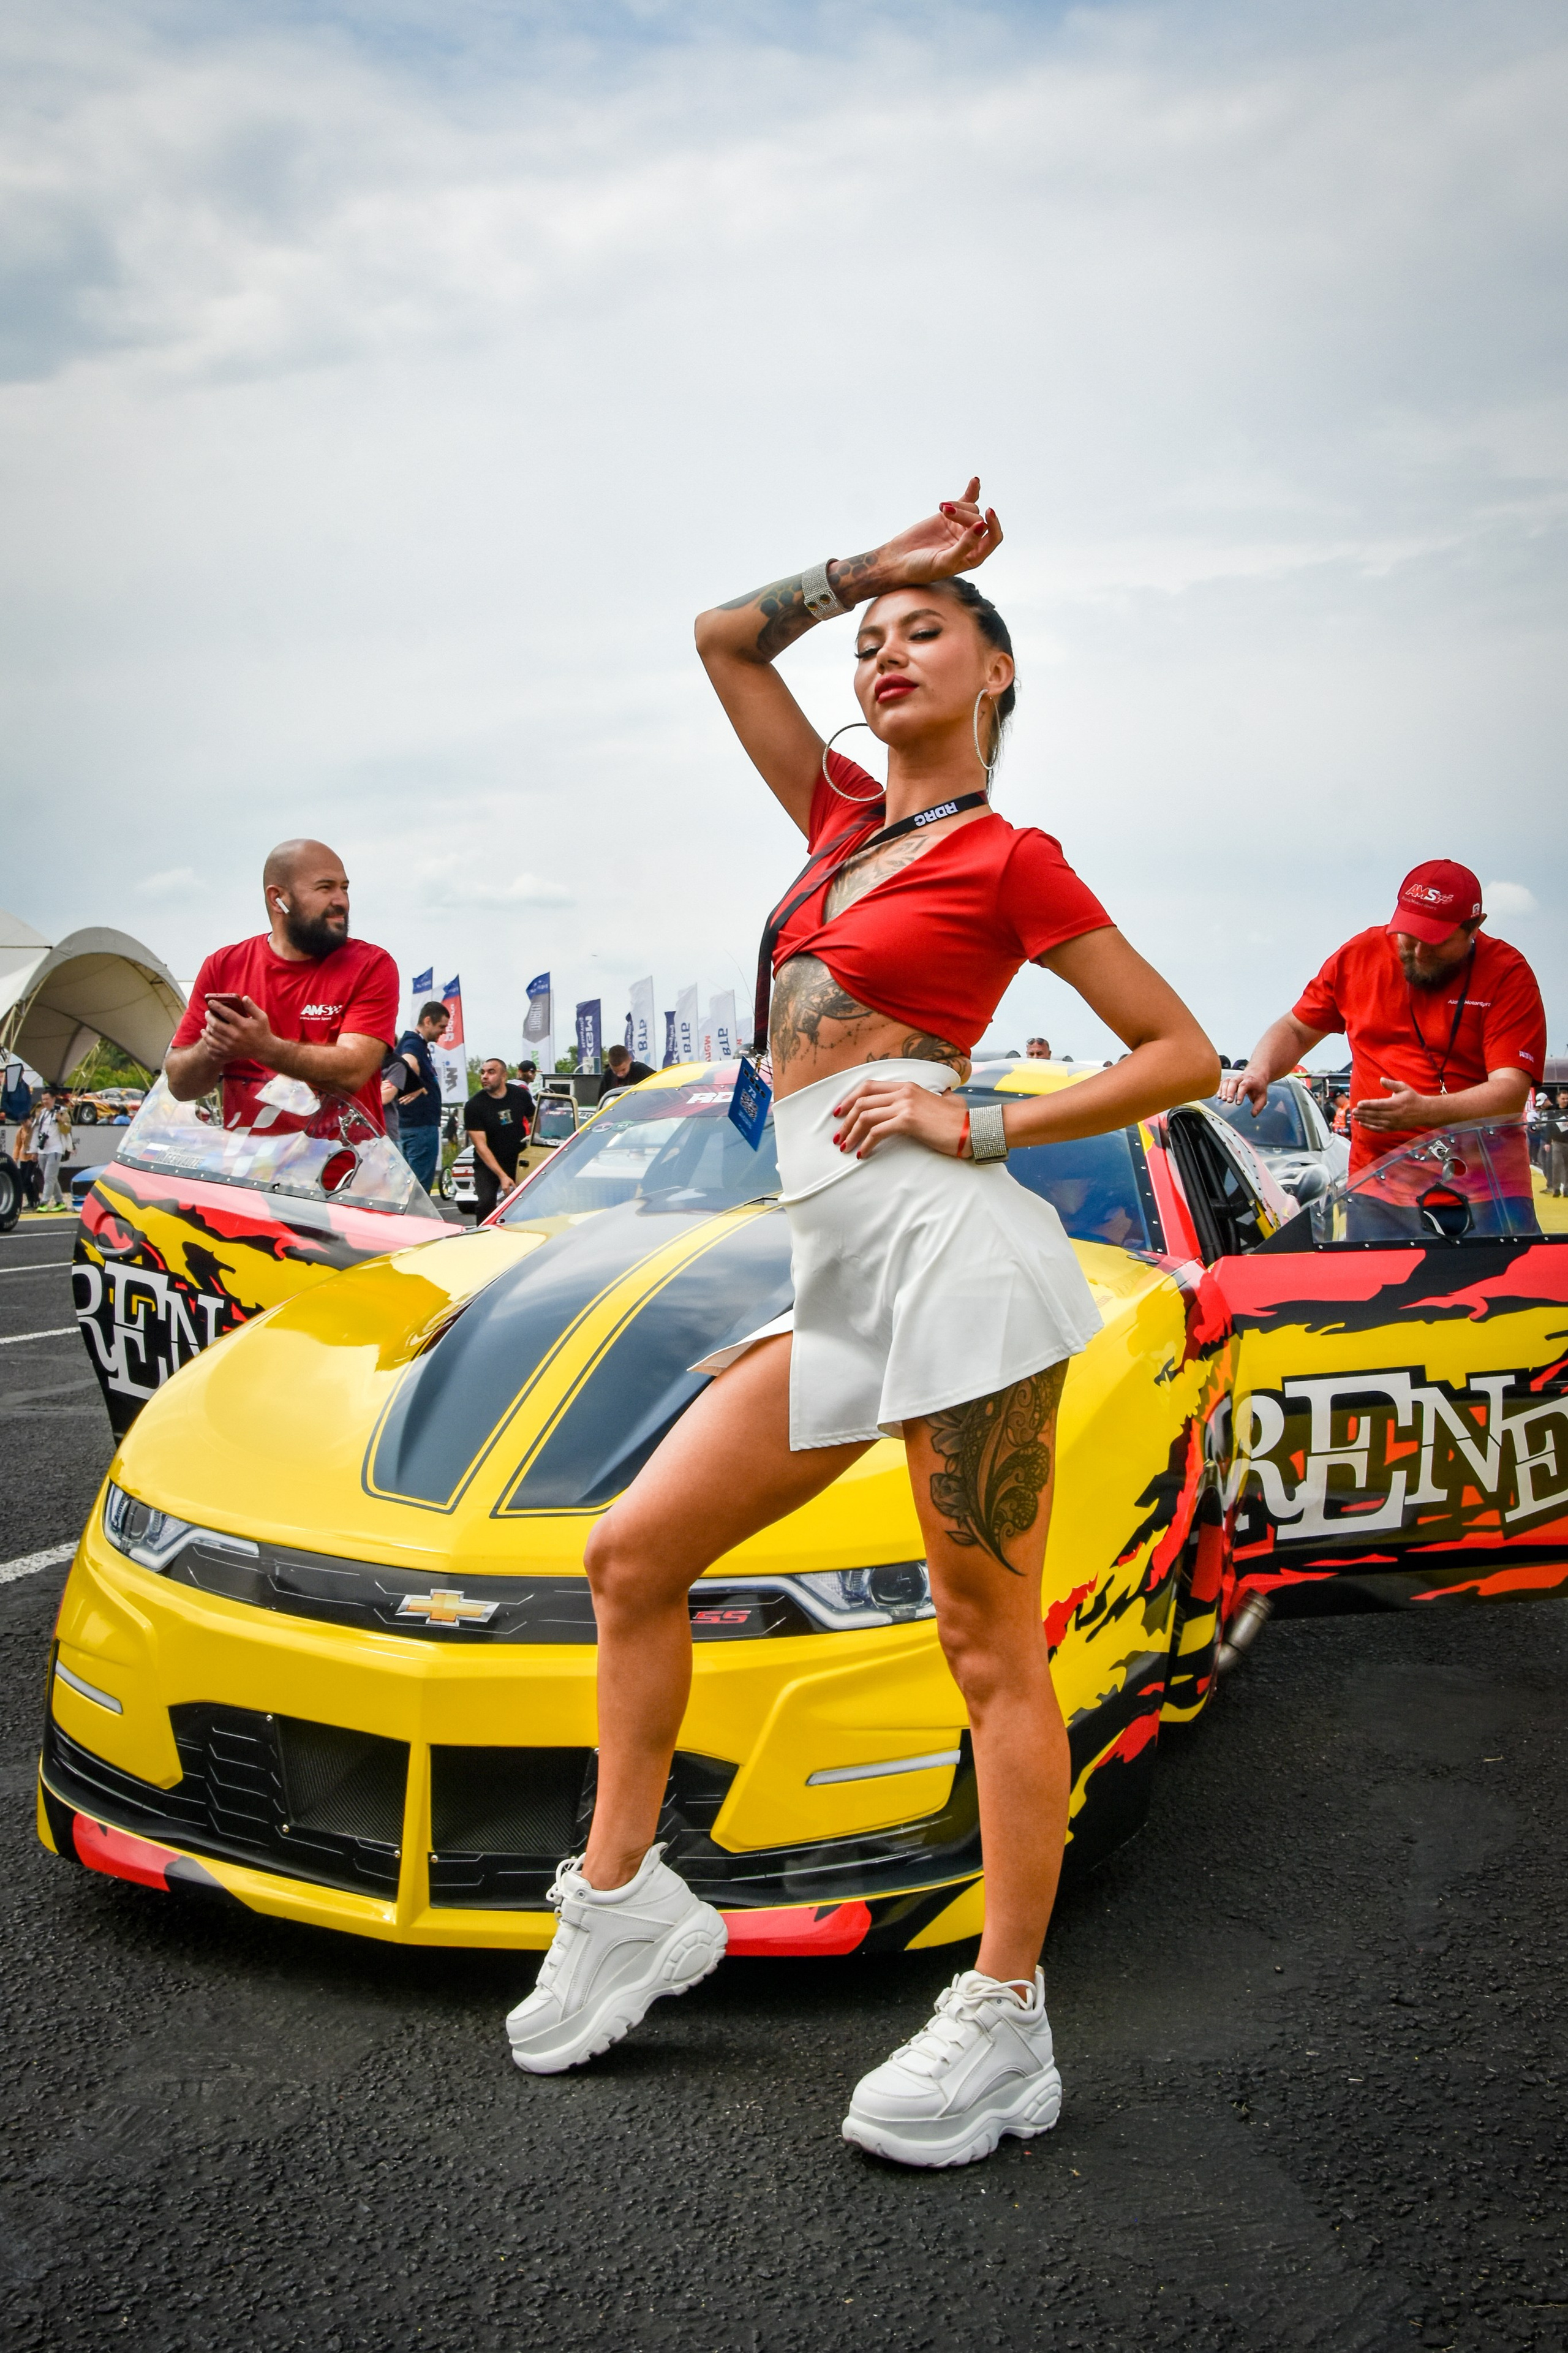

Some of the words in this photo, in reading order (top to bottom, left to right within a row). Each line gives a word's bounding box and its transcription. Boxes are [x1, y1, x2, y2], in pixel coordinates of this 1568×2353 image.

[914, 802, 959, 827] RDRC
[1405, 883, 1441, 904] AMS
[301, 1005, 334, 1016] AMS
[72, 1261, 224, 1400] REN
[690, 1611, 751, 1624] SS
